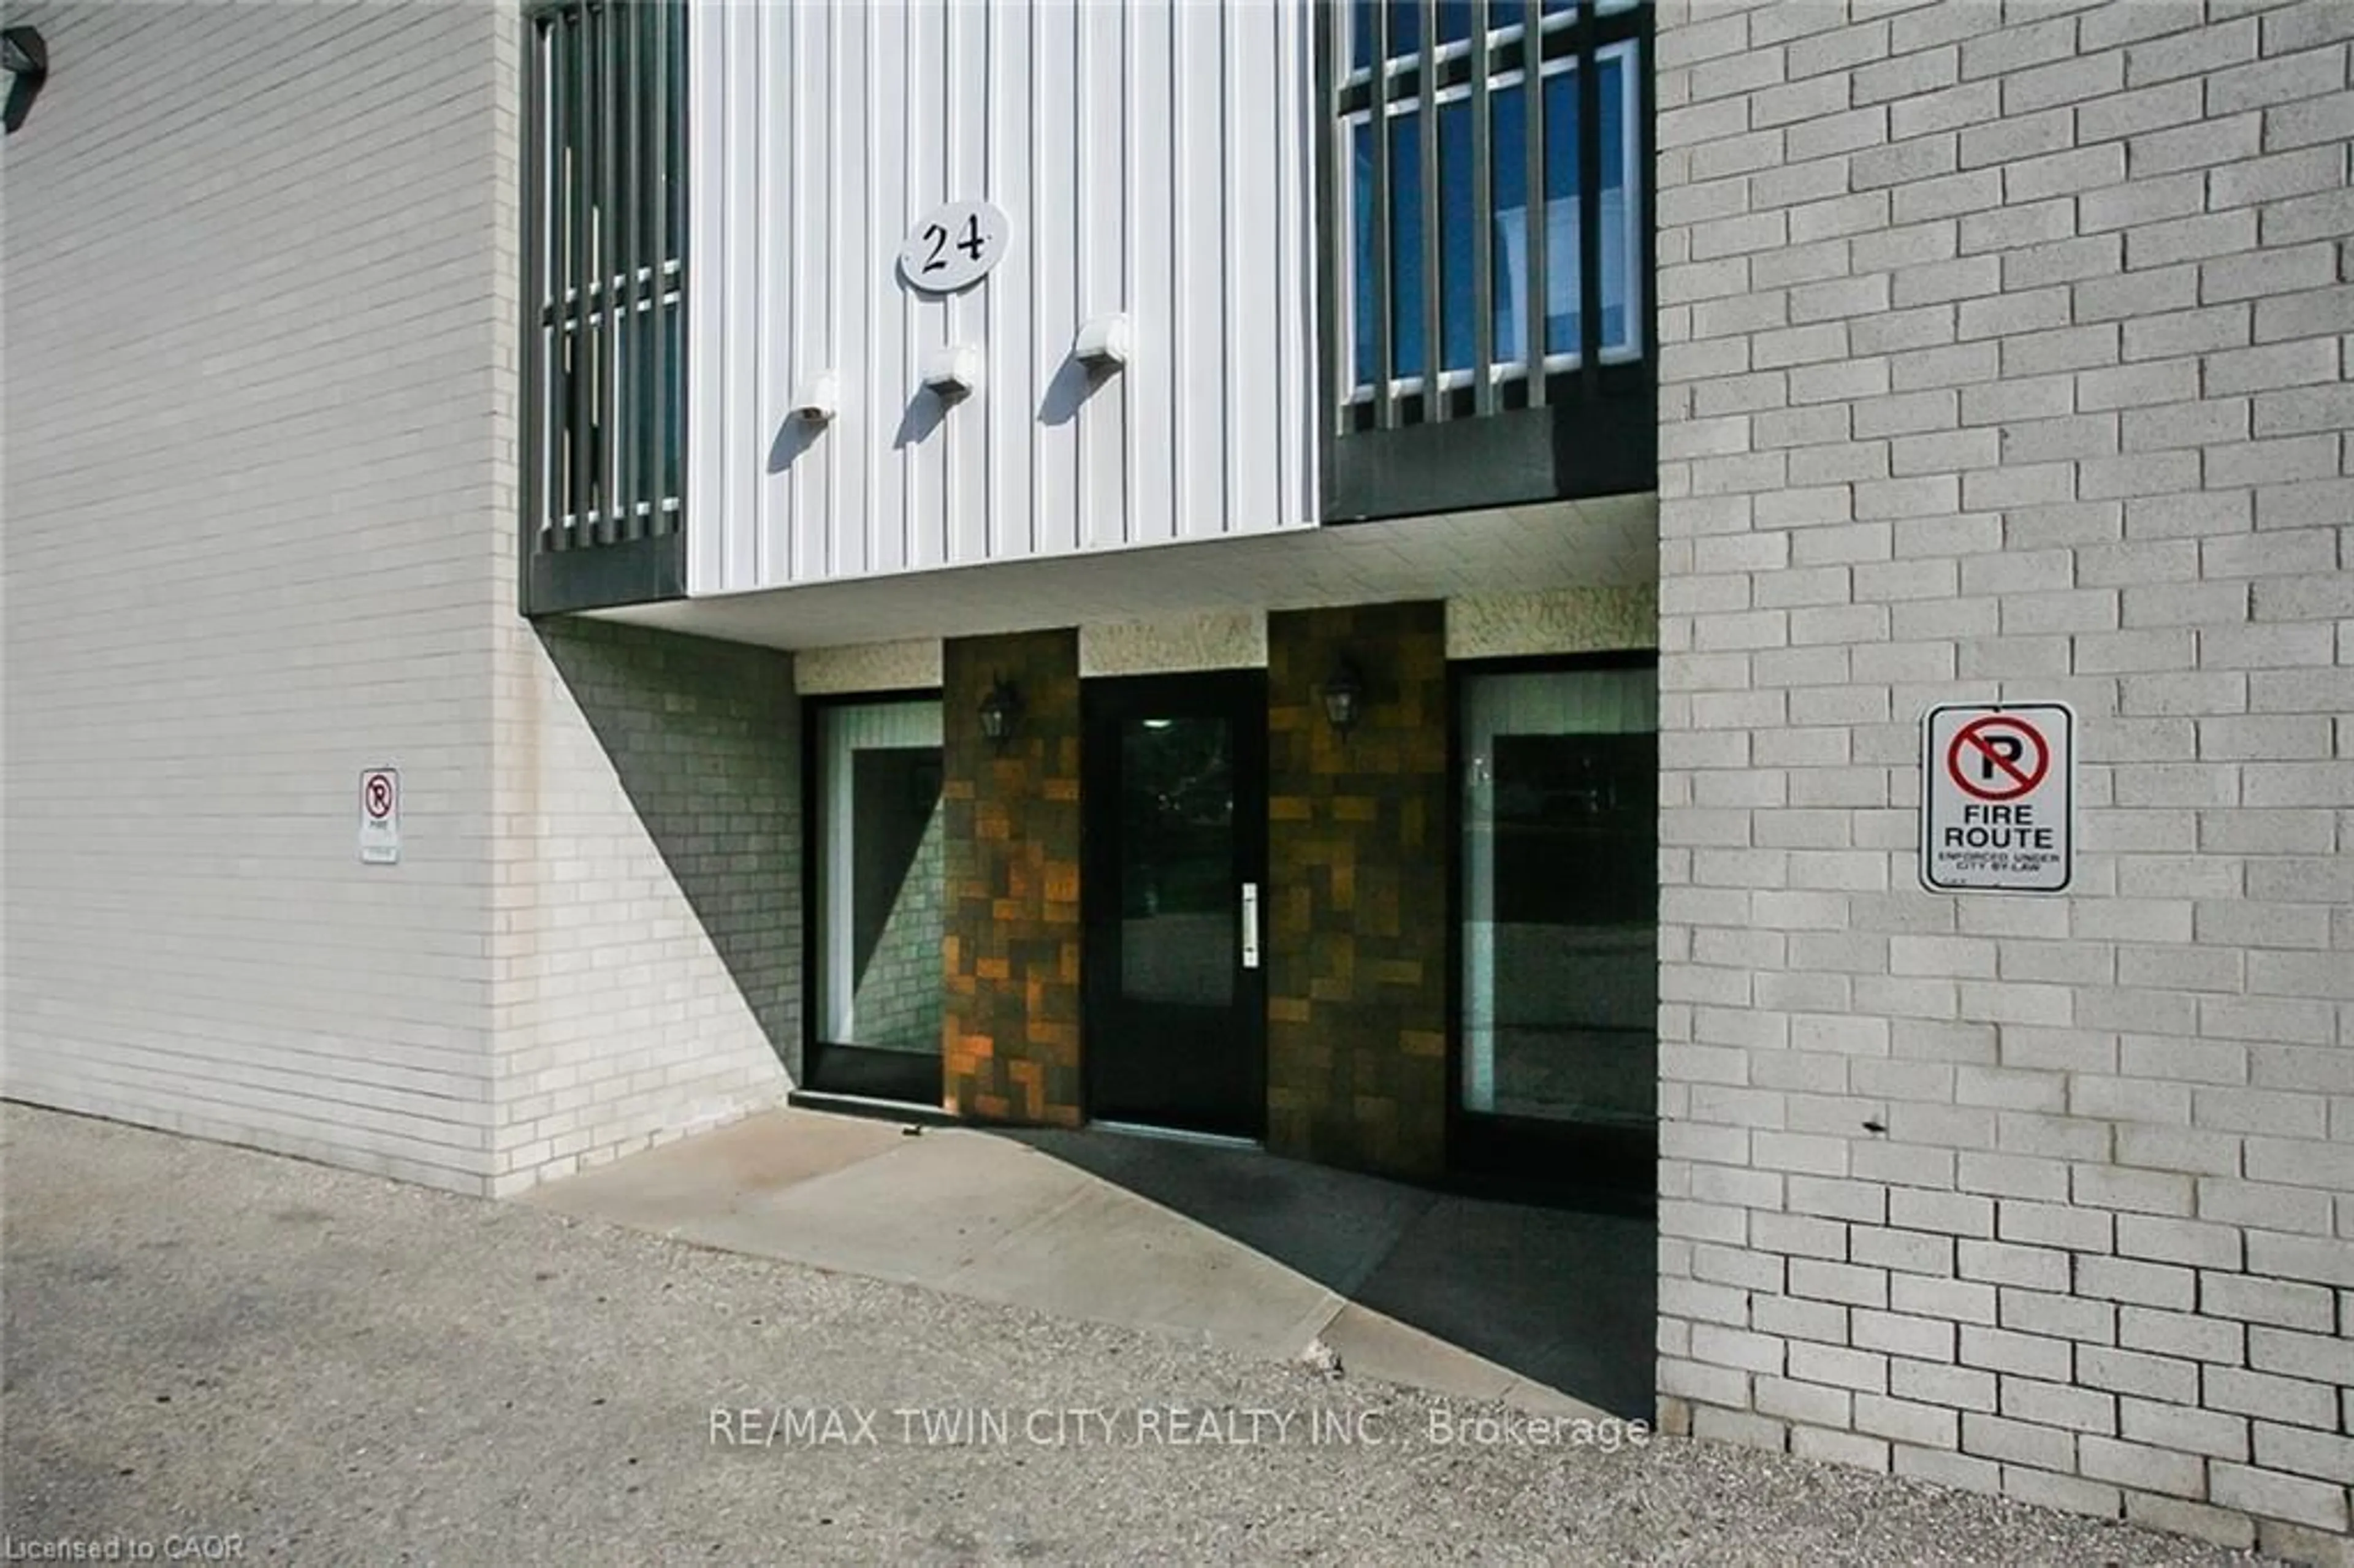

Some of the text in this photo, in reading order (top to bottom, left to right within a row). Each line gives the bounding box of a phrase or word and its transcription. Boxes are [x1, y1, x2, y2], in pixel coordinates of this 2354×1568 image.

[921, 213, 984, 274] 24
[1964, 804, 2033, 825] FIRE
[1945, 827, 2054, 849] ROUTE
[1938, 851, 2060, 862] ENFORCED UNDER
[1956, 861, 1985, 870] CITY
